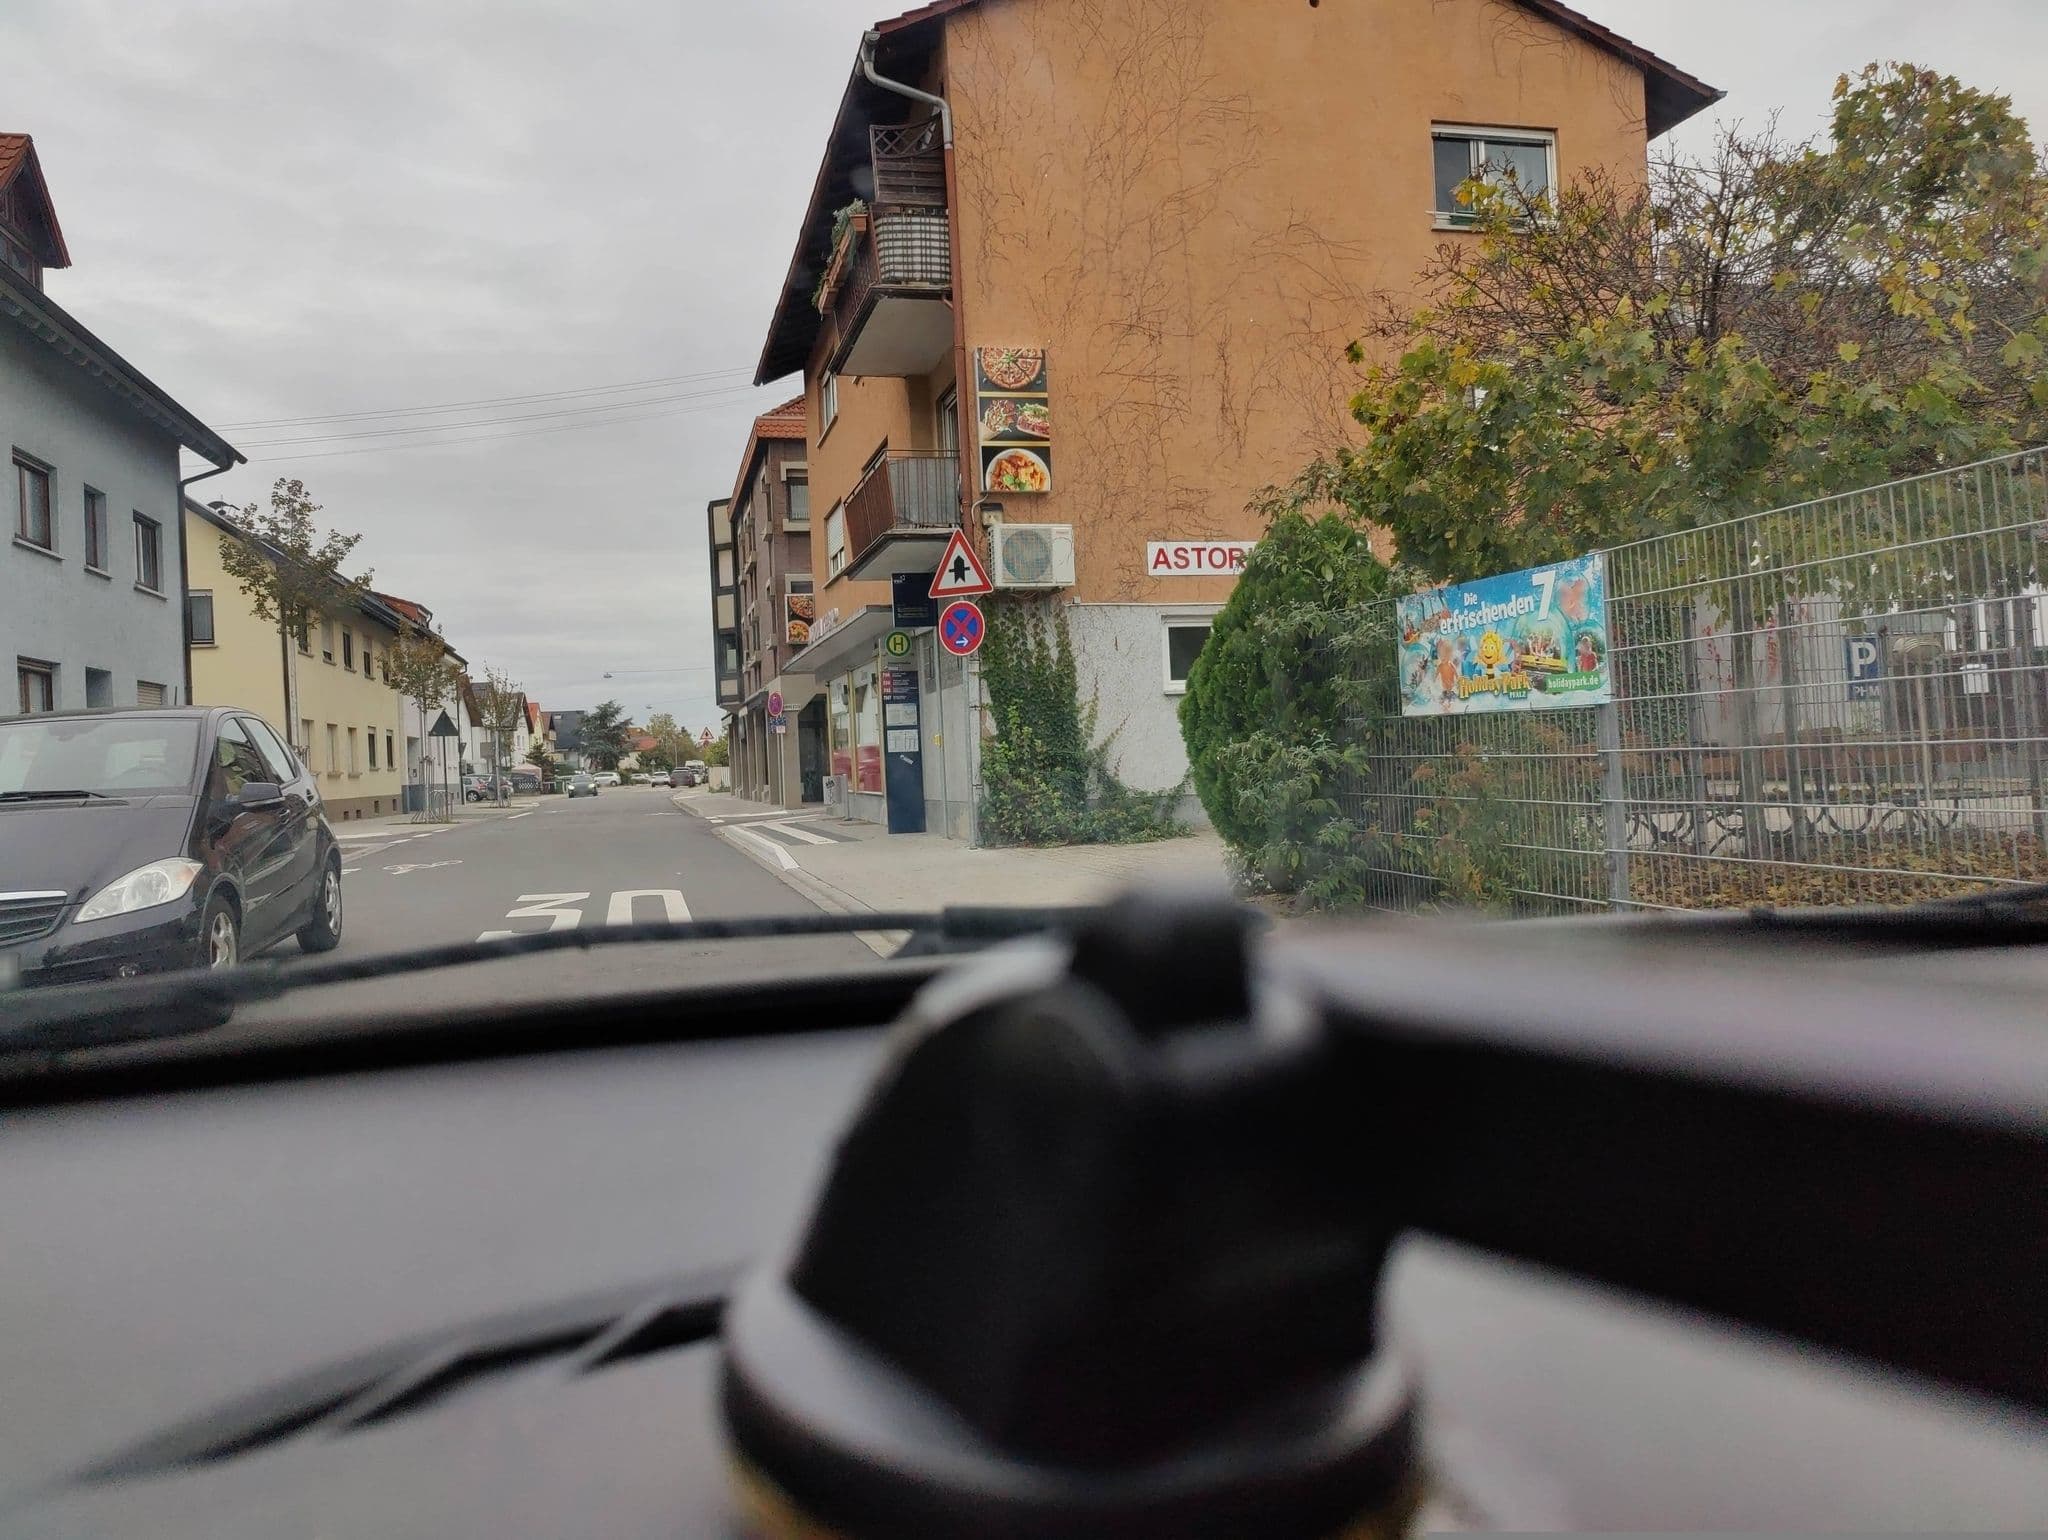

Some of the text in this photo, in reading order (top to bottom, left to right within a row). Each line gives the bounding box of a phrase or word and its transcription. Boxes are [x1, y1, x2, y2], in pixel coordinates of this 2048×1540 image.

[1152, 547, 1252, 570] ASTOR
[1439, 570, 1556, 635] erfrischenden 7
[1463, 592, 1478, 606] Die
[893, 637, 905, 652] H
[1850, 641, 1877, 677] P
[1458, 671, 1531, 699] Holiday Park
[1547, 675, 1600, 689] holidaypark.de
[475, 889, 693, 943] 30
